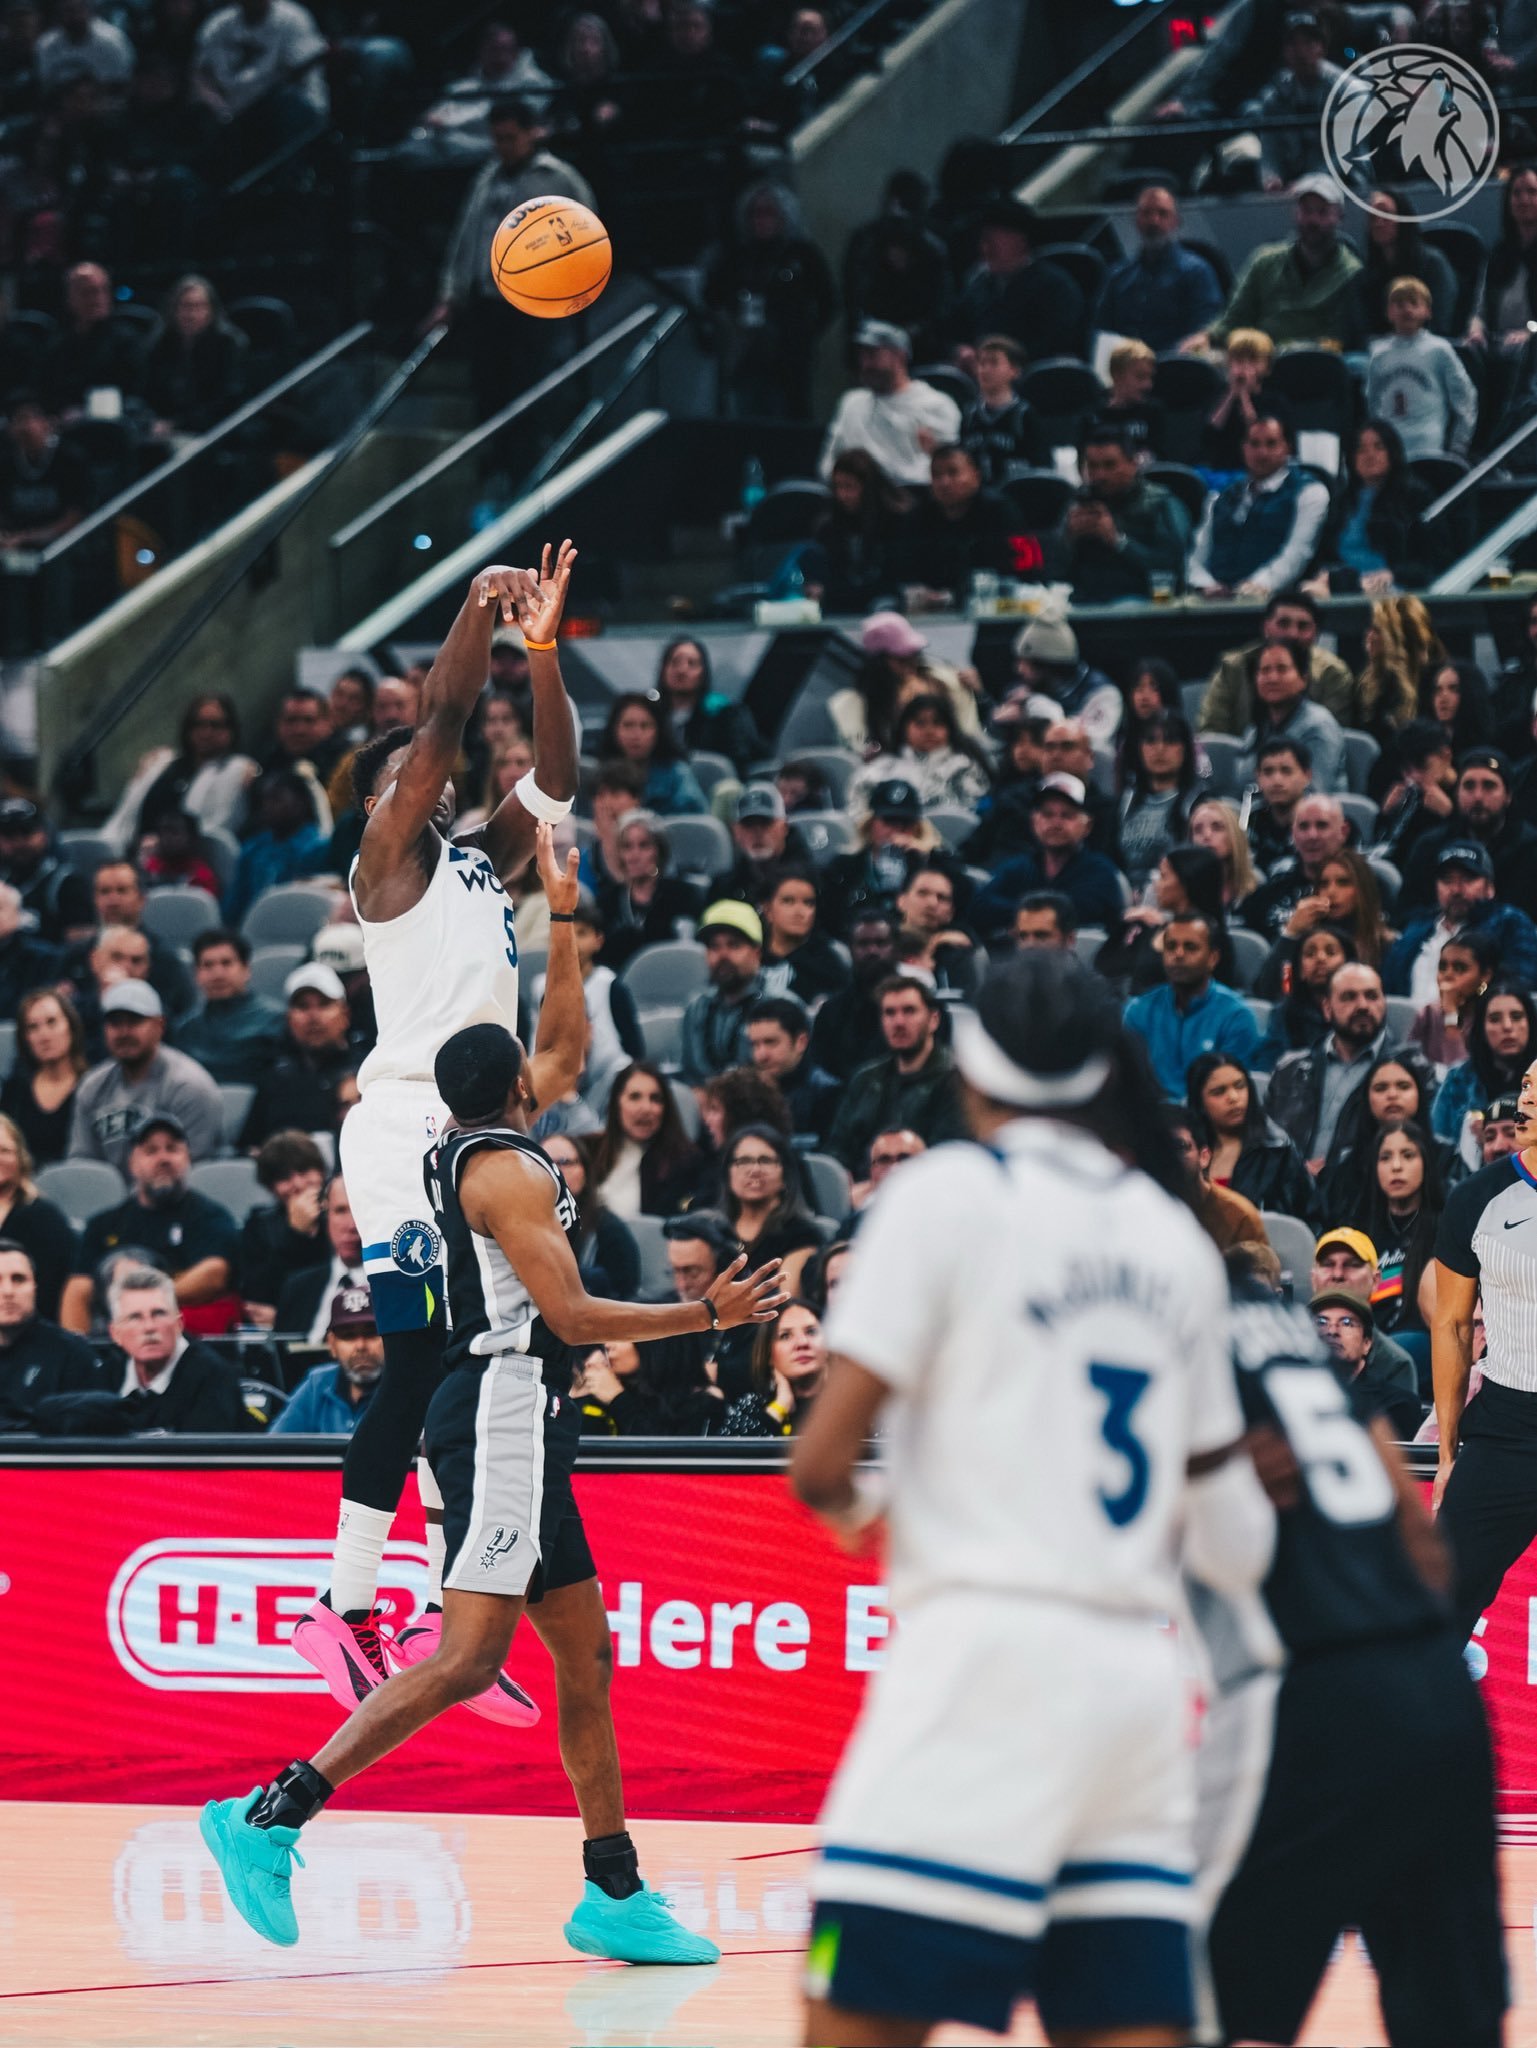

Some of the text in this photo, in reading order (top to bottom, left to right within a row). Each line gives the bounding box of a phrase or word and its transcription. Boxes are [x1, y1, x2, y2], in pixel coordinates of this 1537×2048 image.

[391, 1221, 439, 1265] MINNESOTA TIMBERWOLVES
[1088, 1360, 1150, 1526] 3
[1264, 1360, 1396, 1526] 5
[597, 1582, 811, 1671] Here
